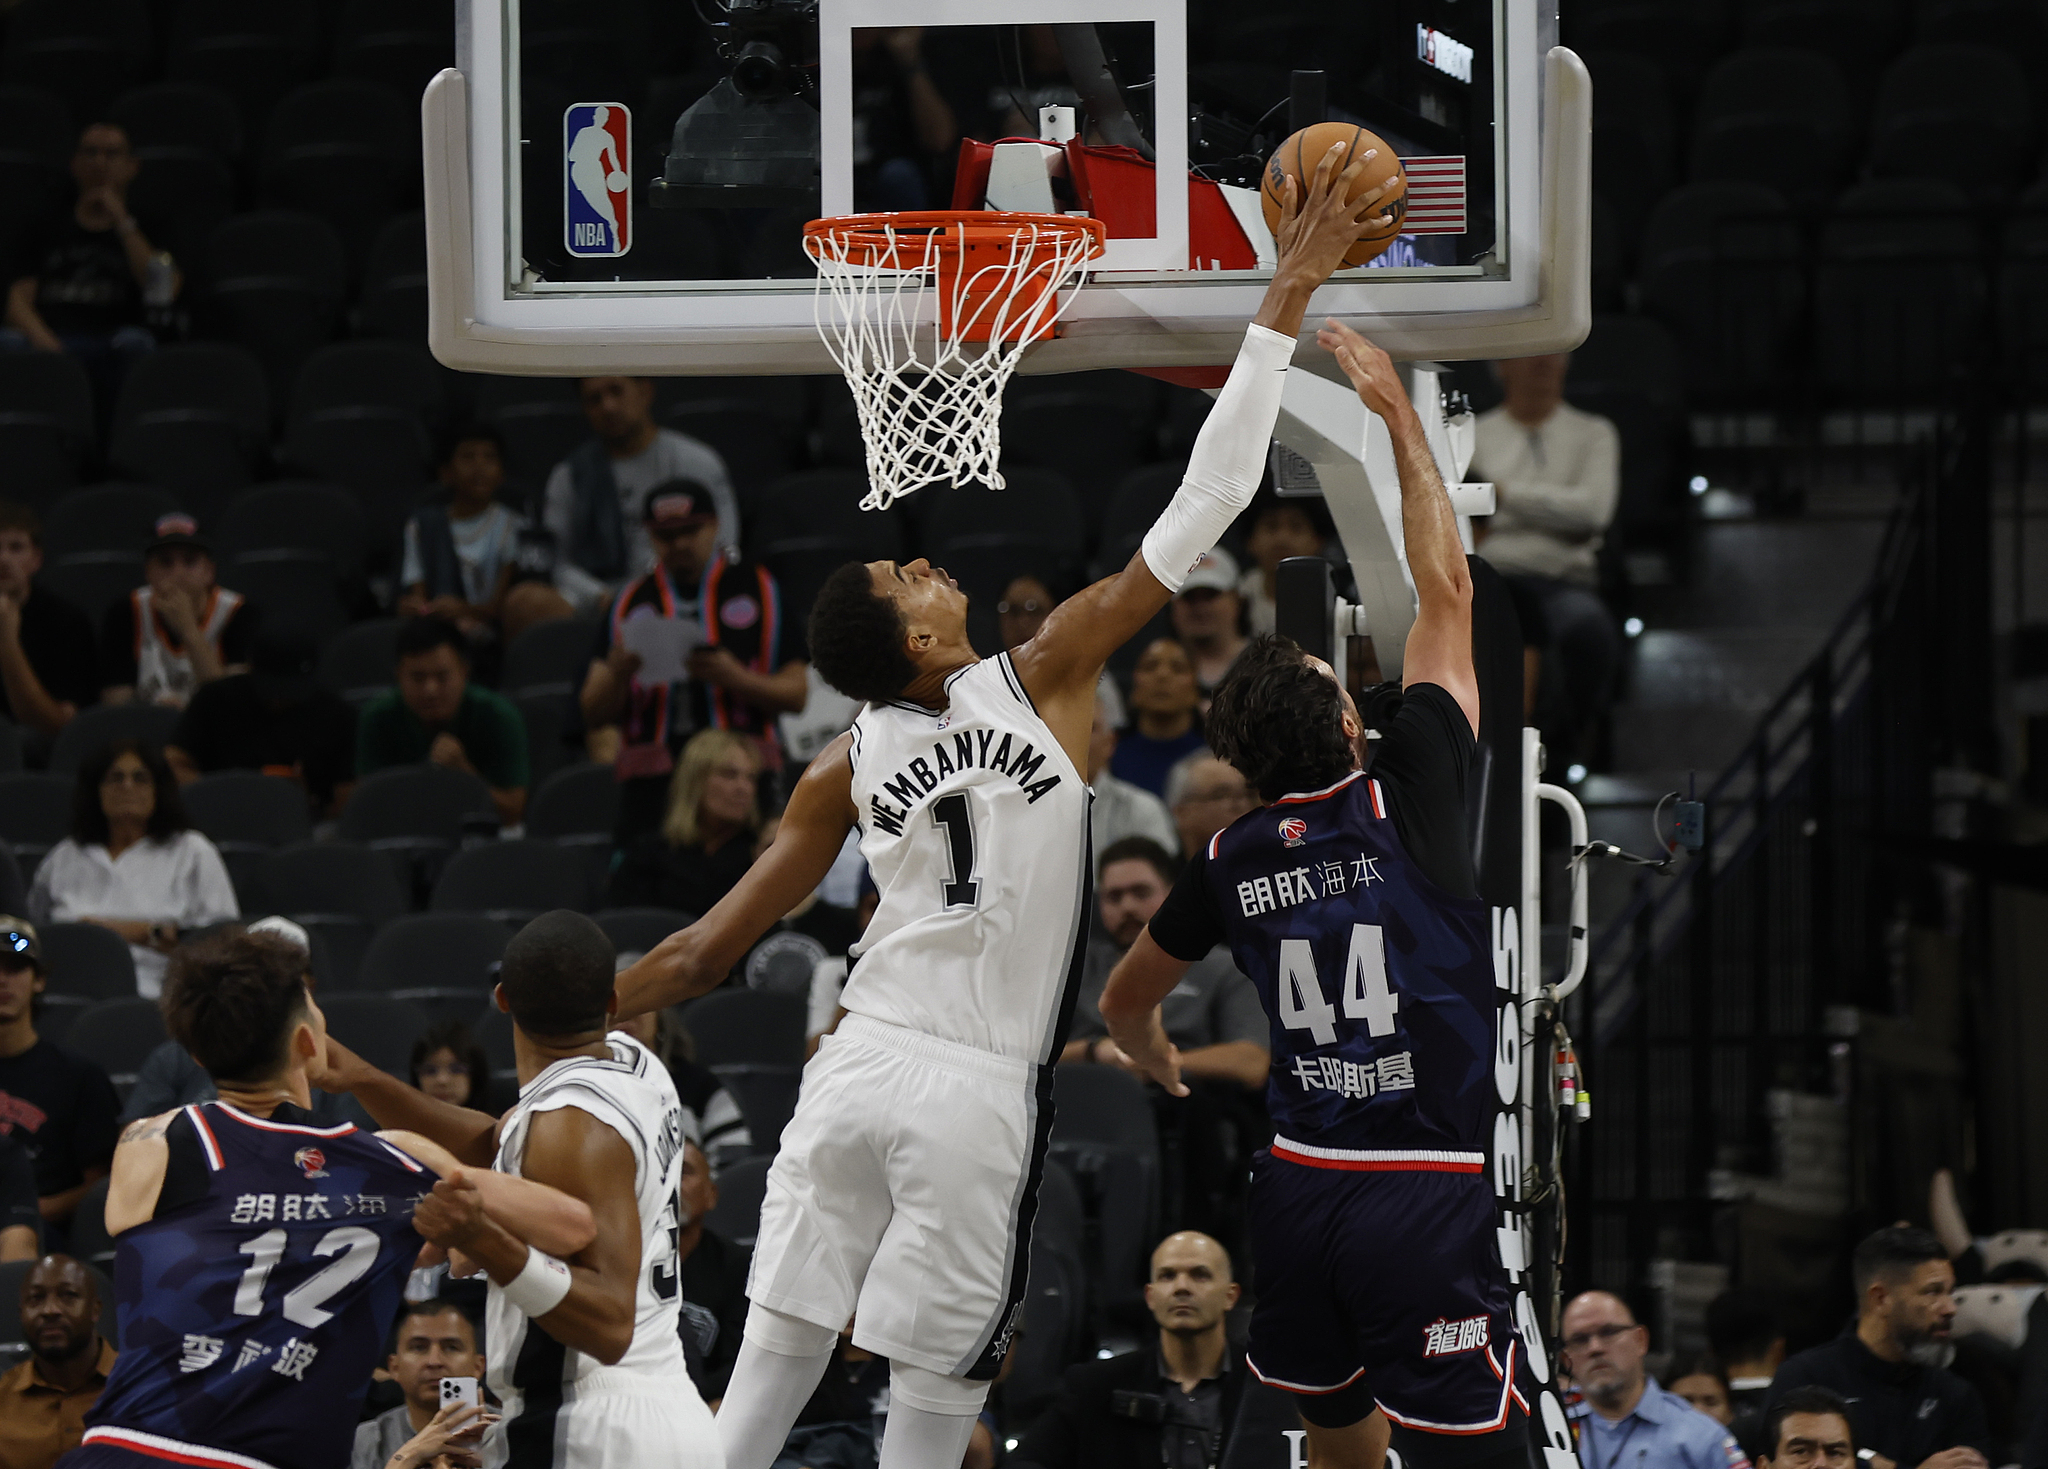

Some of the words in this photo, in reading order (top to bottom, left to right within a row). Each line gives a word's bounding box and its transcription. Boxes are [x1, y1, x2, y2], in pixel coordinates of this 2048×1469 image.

[574, 222, 607, 247] NBA
[872, 728, 1061, 838] WEMBANYAMA
[931, 790, 982, 911] 1
[1236, 852, 1386, 918] 朗肽海本
[1275, 923, 1399, 1045] 44
[1290, 1050, 1416, 1099] 卡明斯基
[1489, 904, 1582, 1469] bet365
[232, 1225, 381, 1329] 12
